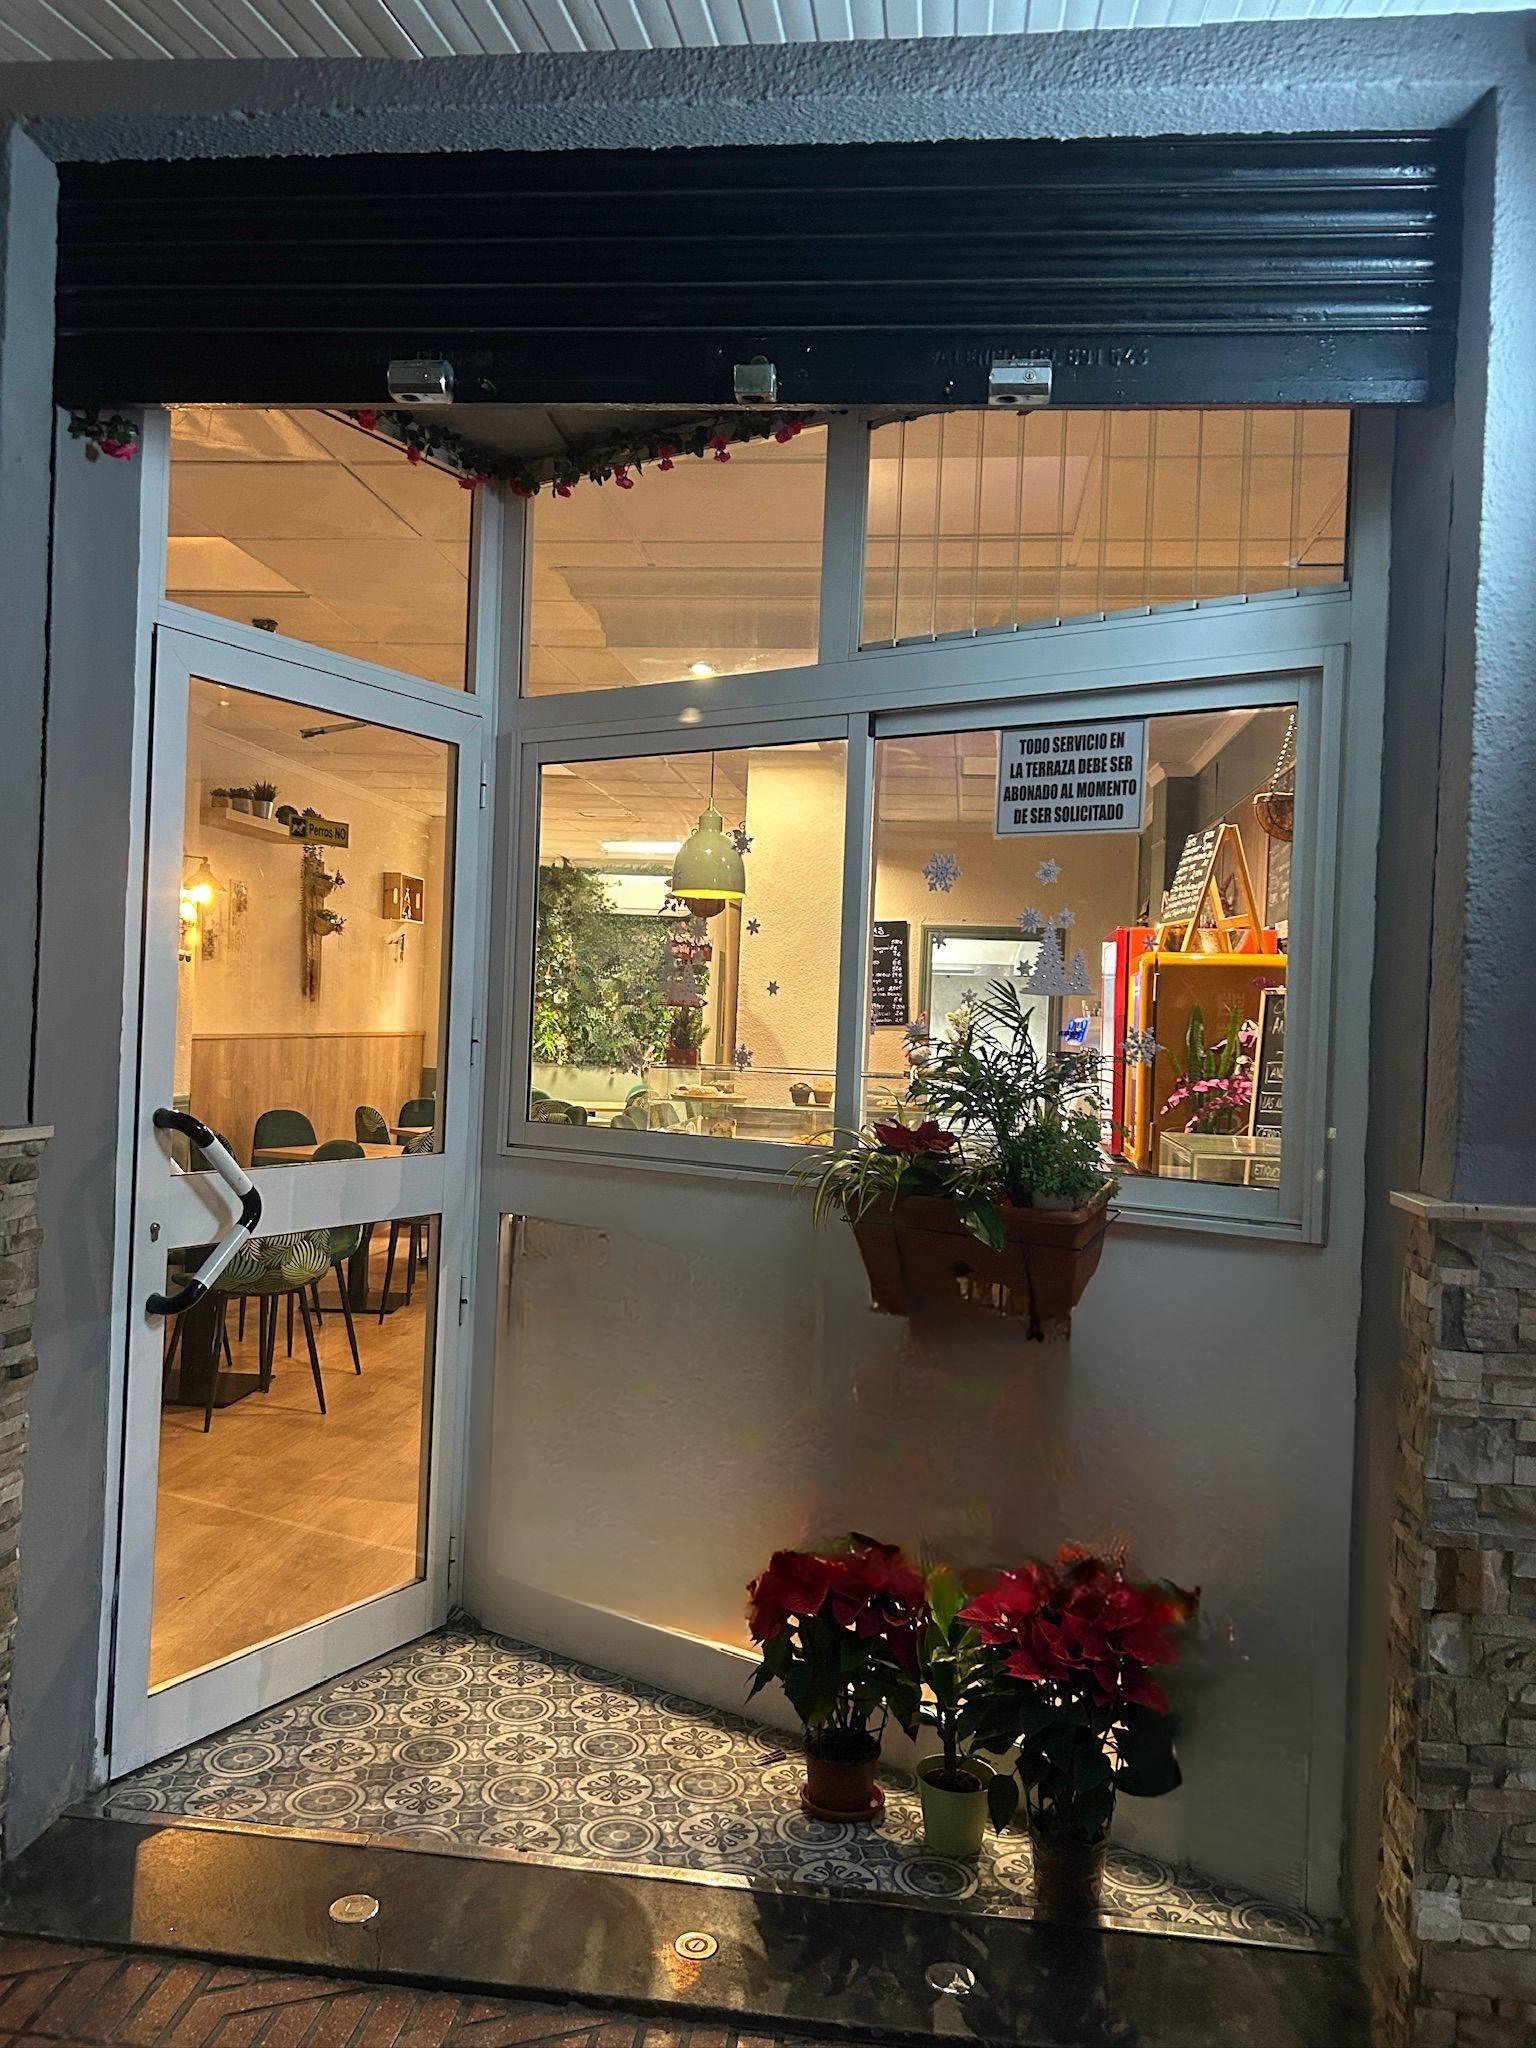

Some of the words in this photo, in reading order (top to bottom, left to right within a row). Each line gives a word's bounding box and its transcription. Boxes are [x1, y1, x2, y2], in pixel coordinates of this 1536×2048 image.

[1020, 737, 1050, 755] TODO
[1052, 733, 1107, 754] SERVICIO
[1110, 732, 1125, 749] EN
[1010, 763, 1023, 779] LA
[1025, 759, 1075, 778] TERRAZA
[1078, 757, 1107, 774] DEBE
[1110, 755, 1133, 772] SER
[1003, 783, 1058, 802] ABONADO
[1060, 783, 1074, 799] AL
[1076, 779, 1137, 798] MOMENTO
[1013, 808, 1027, 824] DE
[1030, 806, 1051, 824] SER
[1054, 803, 1124, 823] SOLICITADO
[309, 823, 333, 838] Perros
[334, 827, 346, 840] NO
